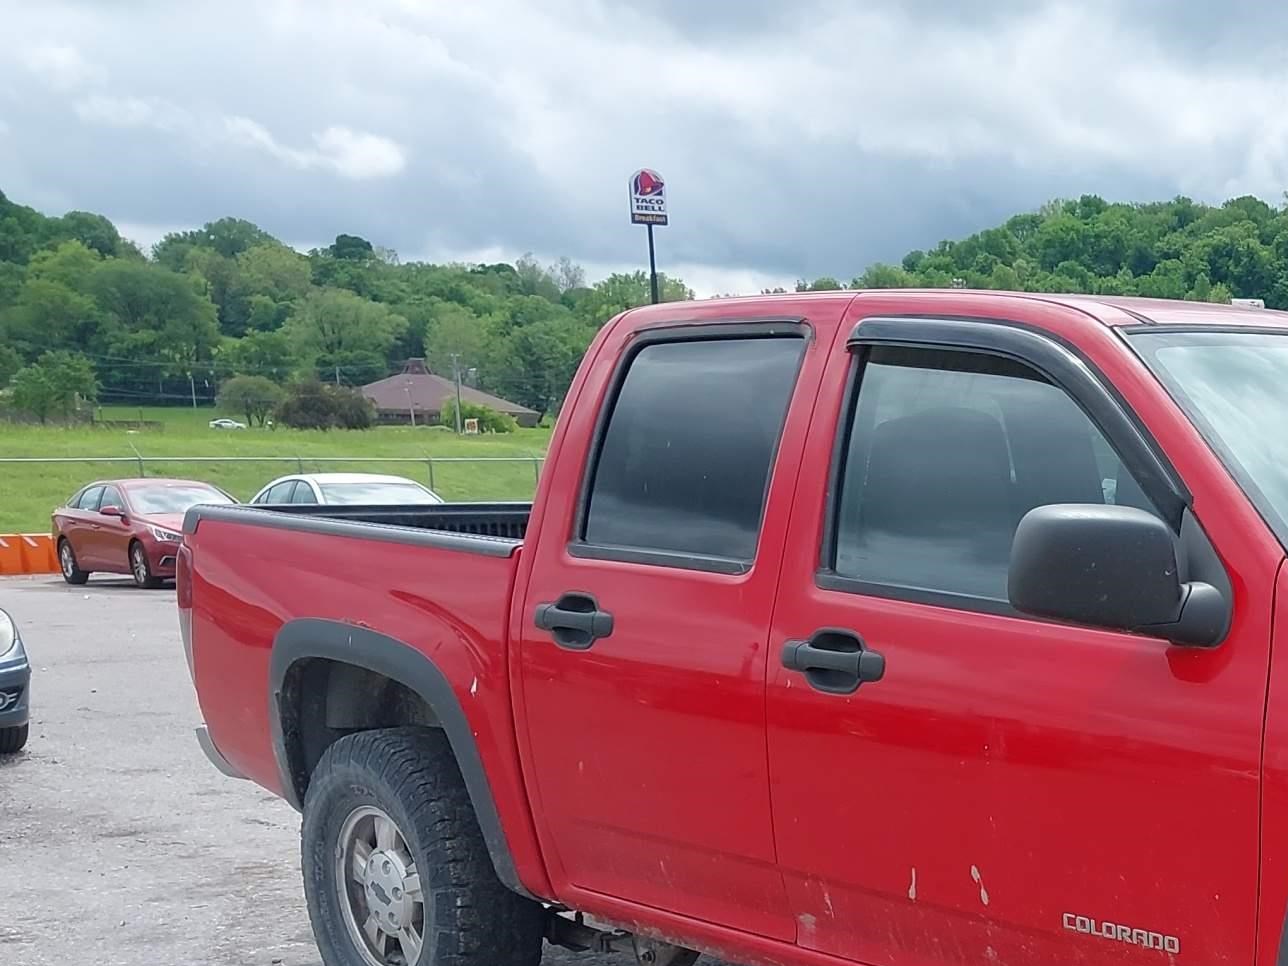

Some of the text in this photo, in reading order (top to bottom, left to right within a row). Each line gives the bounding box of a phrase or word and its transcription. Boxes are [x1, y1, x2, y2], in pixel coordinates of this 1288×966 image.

[634, 197, 664, 205] TACO
[636, 204, 665, 212] BELL
[1063, 912, 1179, 954] COLORADO
